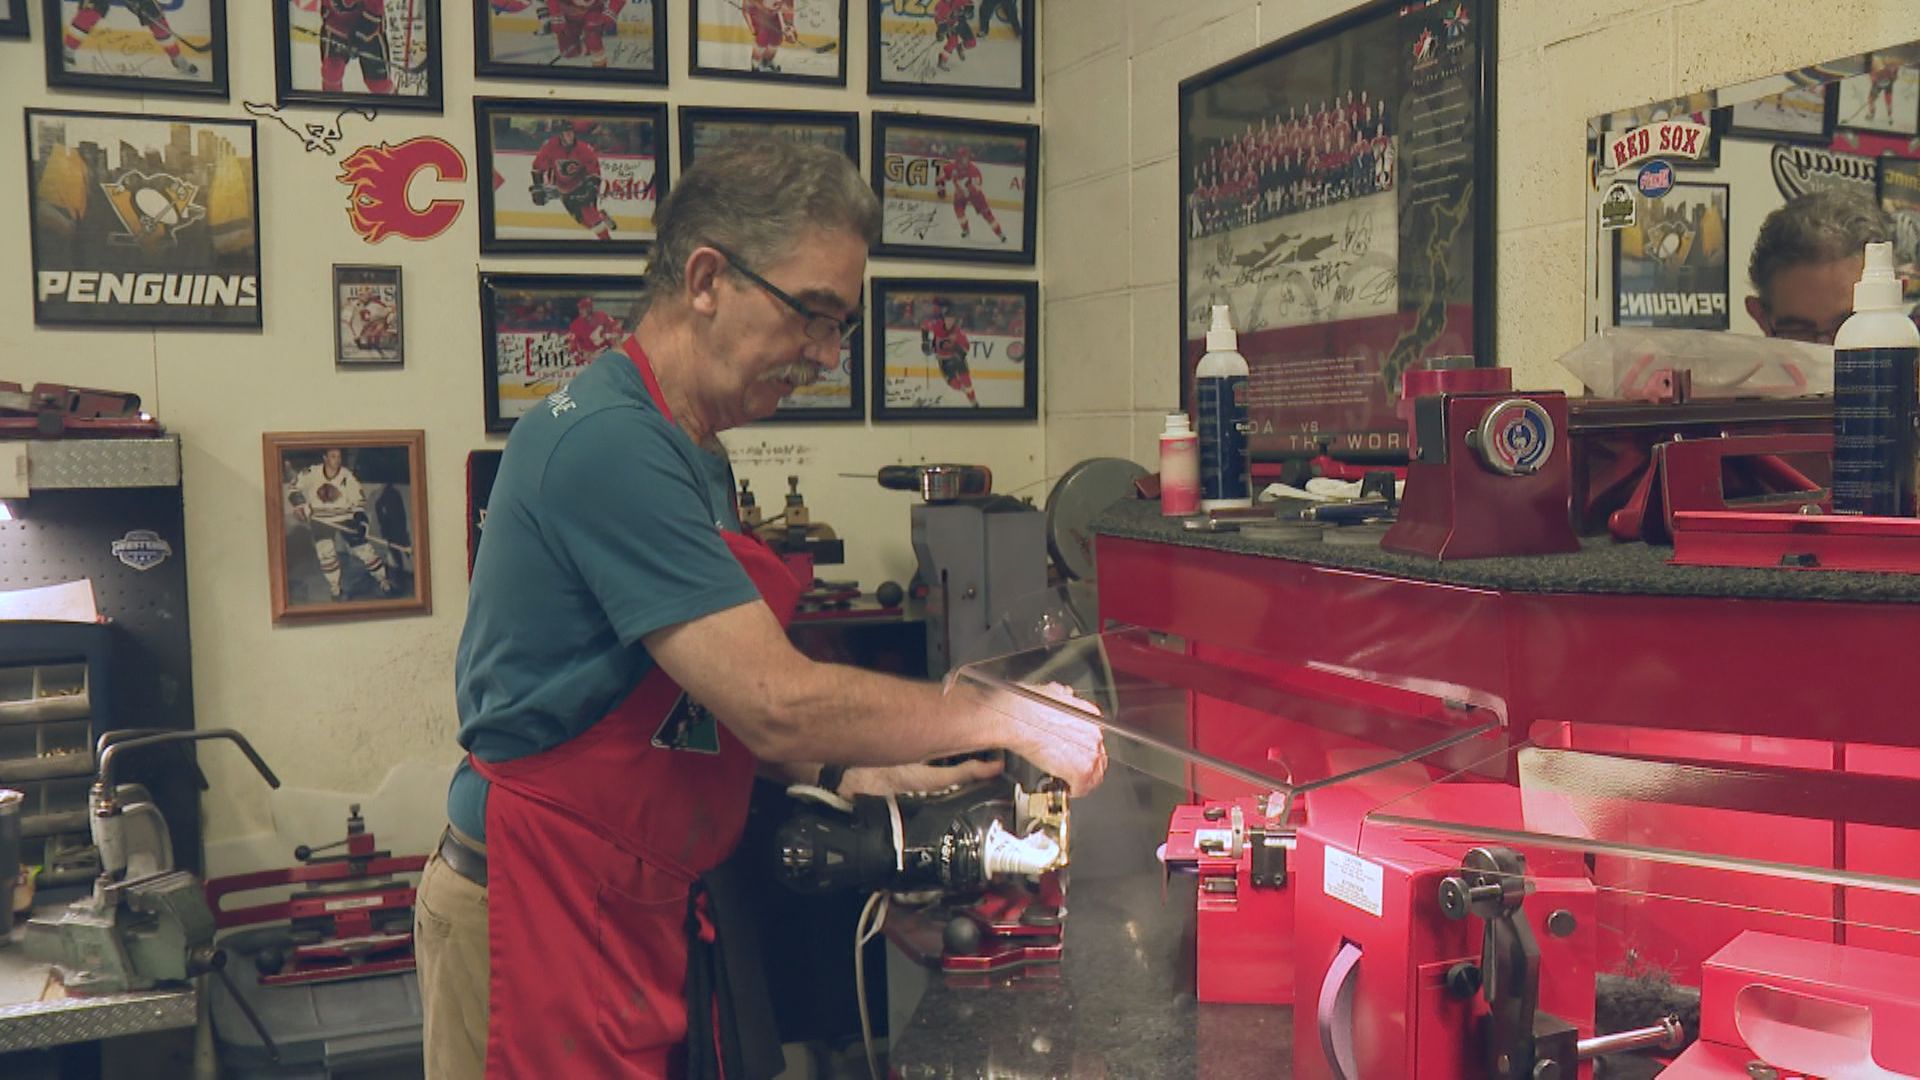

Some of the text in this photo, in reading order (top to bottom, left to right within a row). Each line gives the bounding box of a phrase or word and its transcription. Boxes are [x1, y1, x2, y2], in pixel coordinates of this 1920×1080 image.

[1613, 124, 1701, 167] RED SOX
[37, 270, 257, 307] PENGUINS
[970, 341, 994, 359] TV
